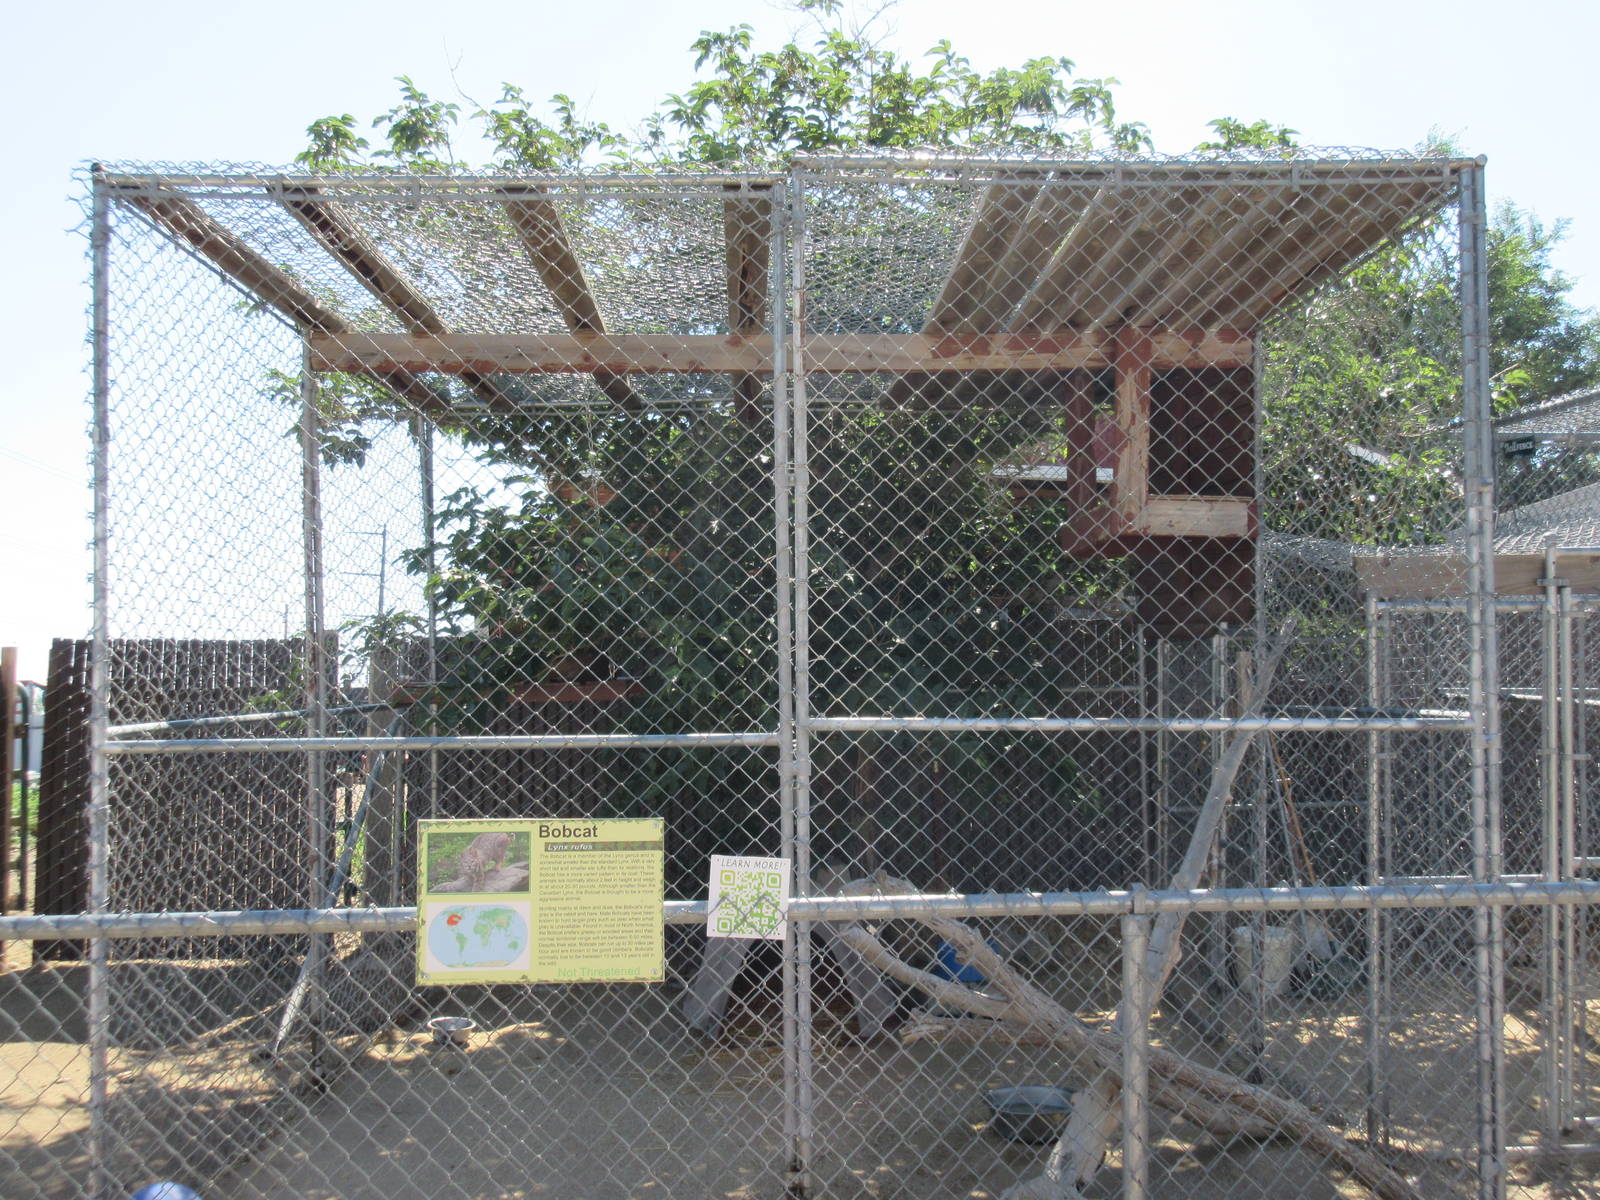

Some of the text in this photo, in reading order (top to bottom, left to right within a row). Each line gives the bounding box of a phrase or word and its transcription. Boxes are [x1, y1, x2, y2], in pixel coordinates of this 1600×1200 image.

[539, 825, 598, 838] Bobcat
[548, 844, 569, 852] Lynx
[721, 858, 783, 870] LEARN MORE!
[558, 967, 640, 977] Not Threatened
